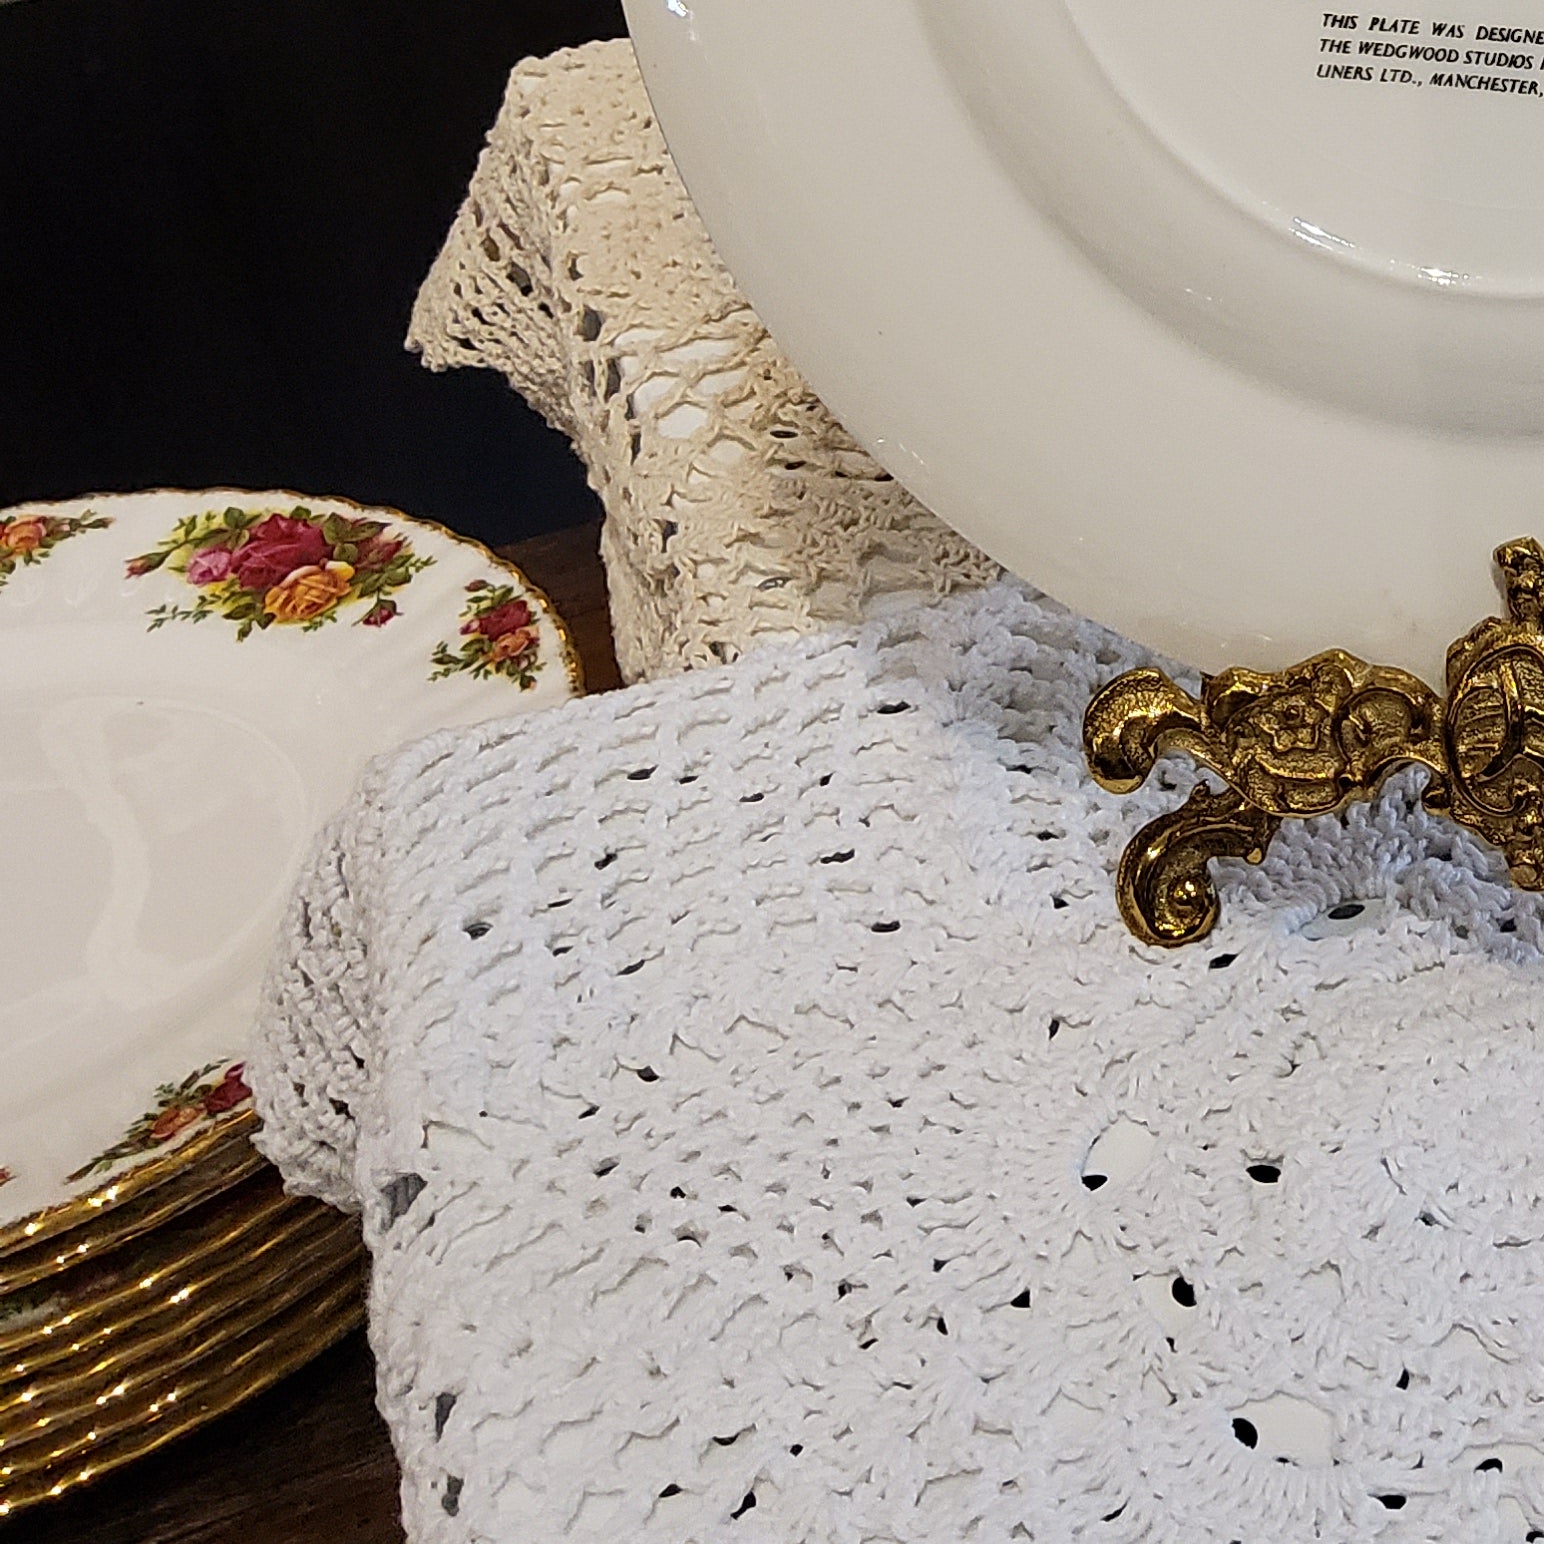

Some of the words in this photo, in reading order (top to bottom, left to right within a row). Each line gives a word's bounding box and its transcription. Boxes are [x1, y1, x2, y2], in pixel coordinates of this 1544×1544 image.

[1323, 14, 1358, 29] THIS
[1368, 17, 1420, 34] PLATE
[1432, 22, 1465, 38] WAS
[1320, 39, 1352, 54] THE
[1359, 41, 1459, 62] WEDGWOOD
[1463, 51, 1534, 69] STUDIOS
[1317, 64, 1373, 81] LINERS
[1380, 69, 1422, 87] LTD.,
[1429, 73, 1543, 97] MANCHESTER,
